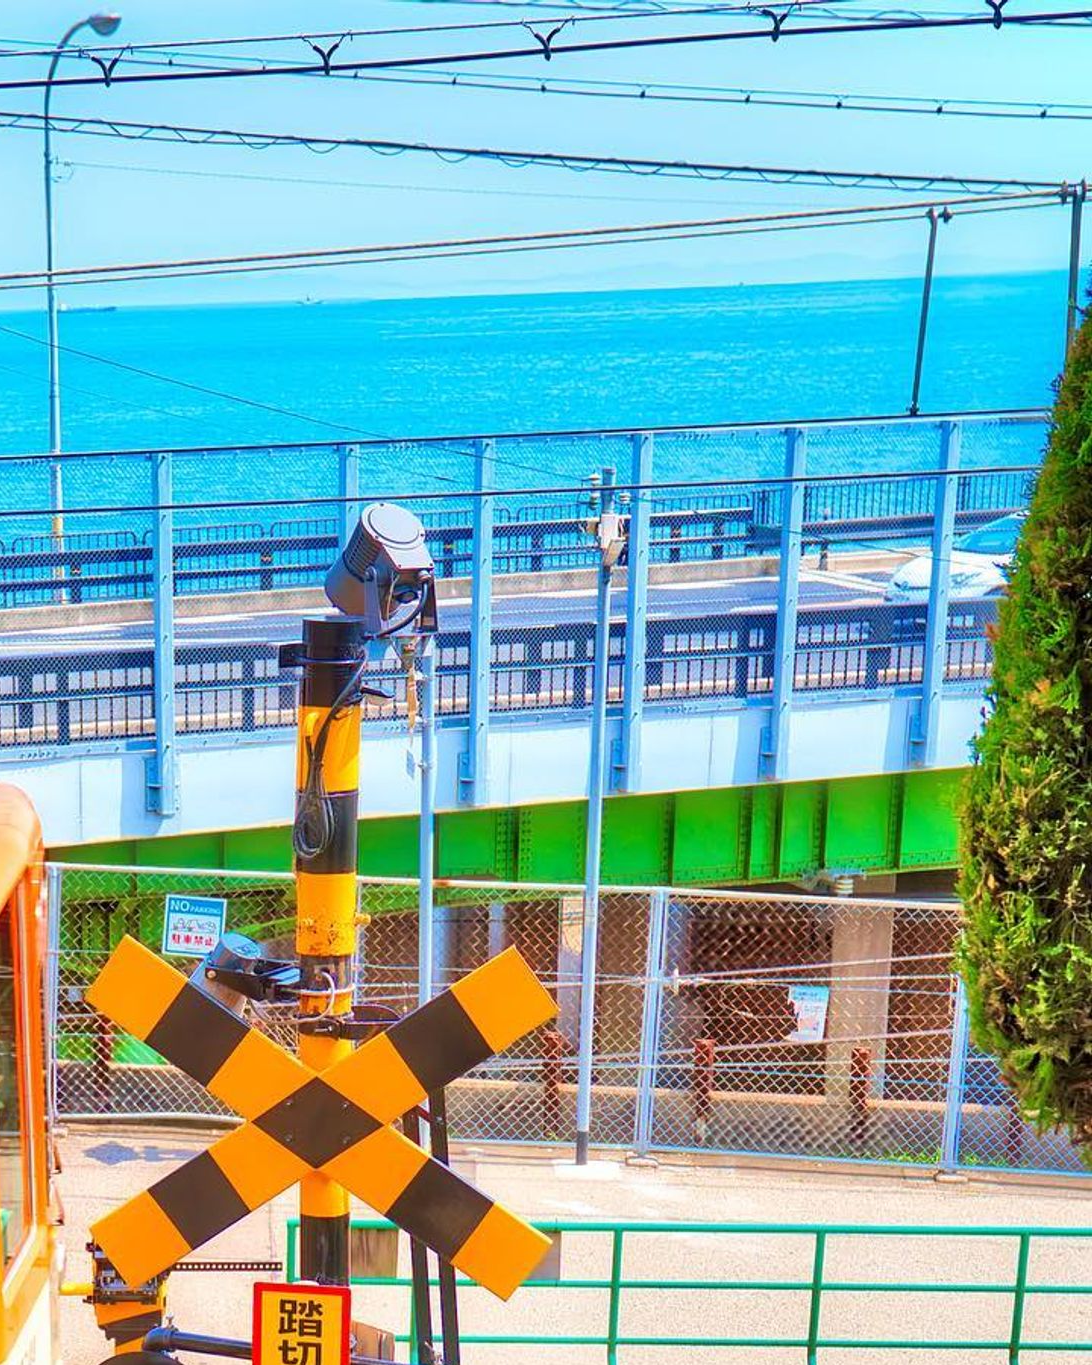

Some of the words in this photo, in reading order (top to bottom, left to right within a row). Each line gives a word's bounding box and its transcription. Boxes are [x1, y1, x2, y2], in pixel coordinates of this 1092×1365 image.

[170, 899, 190, 912] NO
[189, 906, 221, 914] PARKING
[171, 933, 214, 946] 駐車禁止
